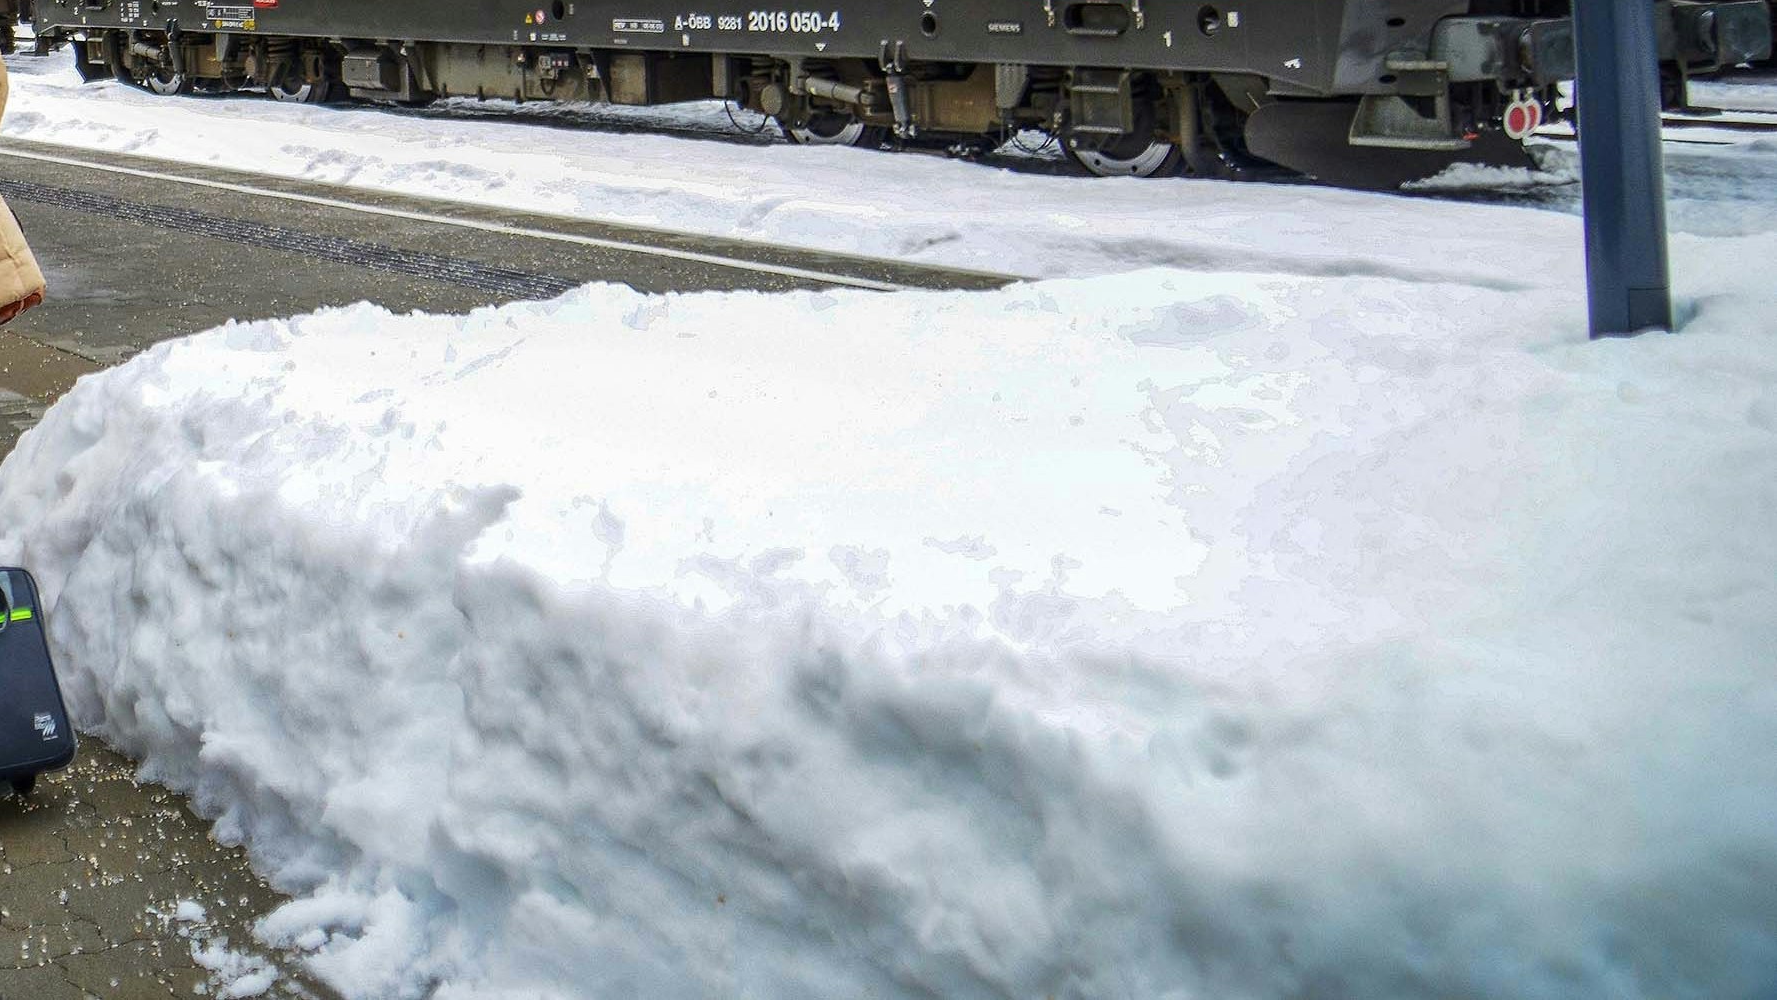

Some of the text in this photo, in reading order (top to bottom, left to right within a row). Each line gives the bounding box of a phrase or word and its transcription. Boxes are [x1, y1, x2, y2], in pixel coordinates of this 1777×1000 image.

[717, 16, 743, 30] 9281
[748, 10, 788, 32] 2016
[790, 10, 841, 33] 050-4
